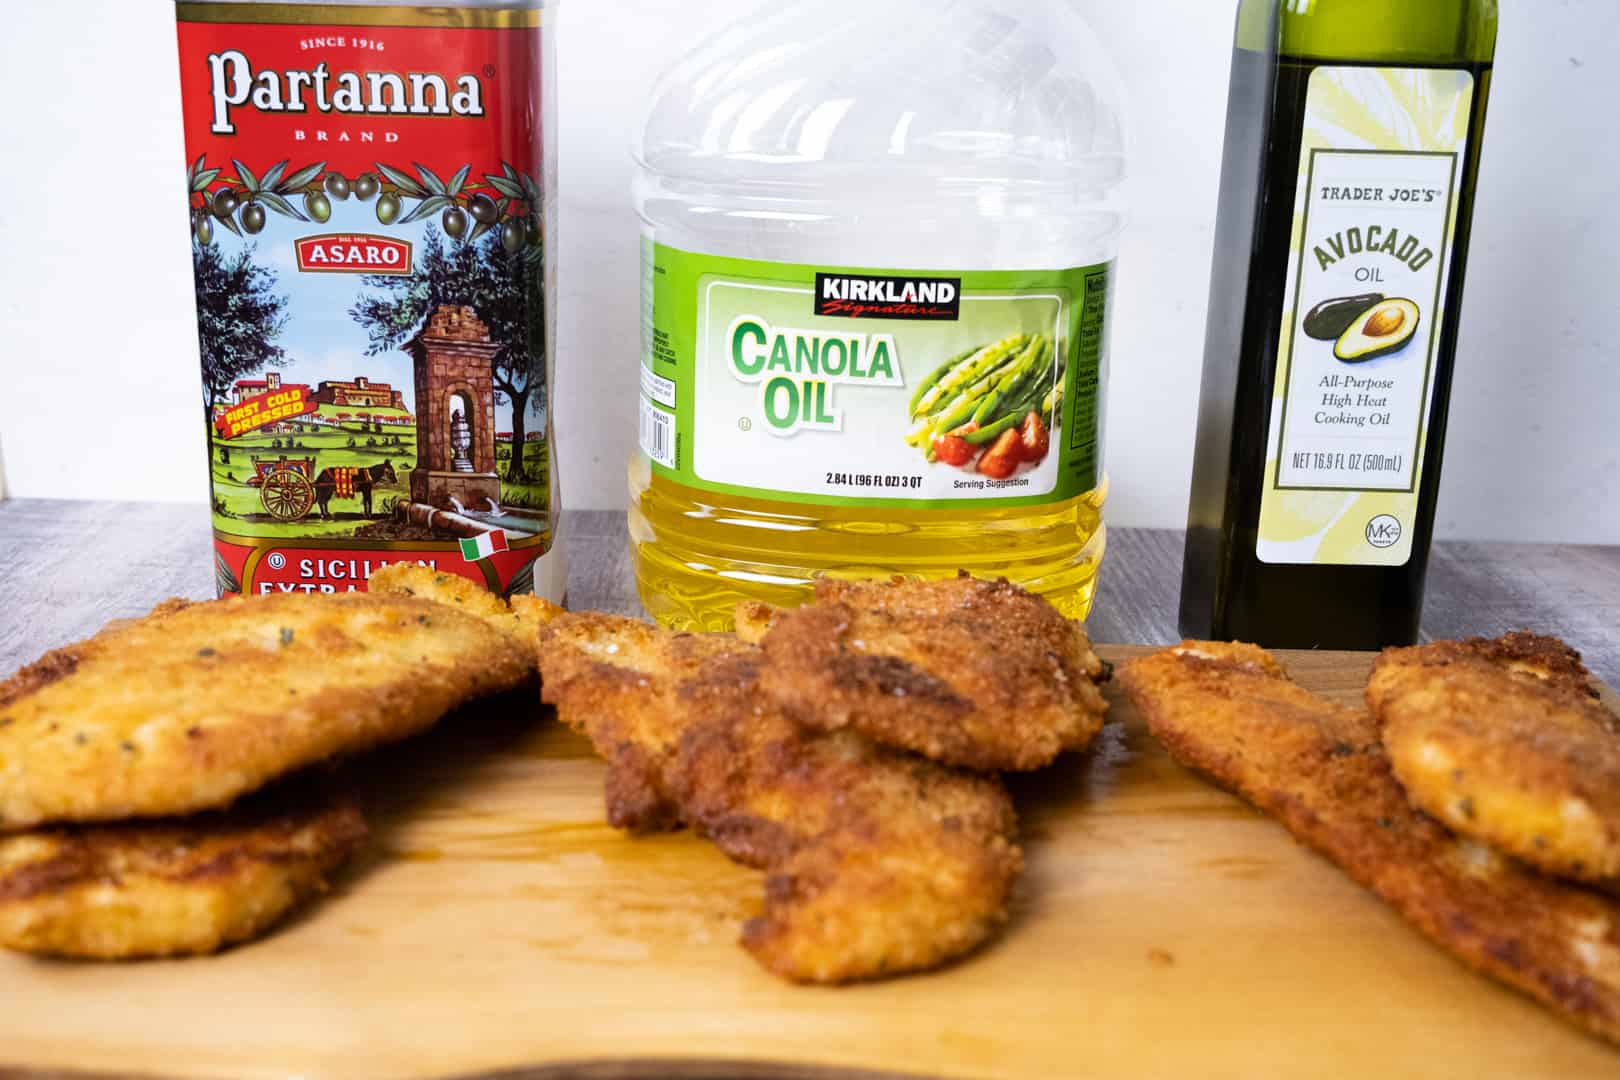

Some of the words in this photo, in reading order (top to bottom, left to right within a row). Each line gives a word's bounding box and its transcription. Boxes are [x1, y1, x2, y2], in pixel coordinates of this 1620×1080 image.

[300, 36, 346, 50] SINCE
[352, 37, 385, 51] 1916
[207, 49, 485, 135] Partanna
[295, 129, 399, 143] BRAND
[1321, 186, 1383, 201] TRADER
[1389, 188, 1436, 202] JOE'S
[309, 244, 400, 265] ASARO
[1313, 225, 1433, 272] AVOCADO
[1354, 267, 1385, 282] OIL
[823, 277, 956, 304] KIRKLAND
[821, 298, 953, 319] Signature
[731, 320, 895, 379] CANOLA
[1318, 375, 1394, 391] All-Purpose
[225, 401, 260, 424] FIRST
[267, 389, 301, 408] COLD
[764, 376, 835, 429] OIL
[1321, 393, 1352, 408] High
[1356, 394, 1387, 407] Heat
[231, 401, 305, 435] PRESSED
[1314, 411, 1365, 427] Cooking
[1369, 412, 1390, 425] Oil
[1292, 452, 1312, 469] NET
[1313, 452, 1333, 470] 16.9
[1335, 453, 1345, 470] FL
[1348, 453, 1361, 471] OZ
[1363, 454, 1402, 472] (500mL)
[826, 472, 847, 485] 2.84
[849, 474, 853, 486] L
[874, 475, 883, 487] FL
[902, 476, 908, 488] 3
[910, 476, 923, 489] QT
[953, 480, 985, 491] Serving
[985, 478, 1029, 490] Suggestion
[300, 559, 436, 579] SICIL
